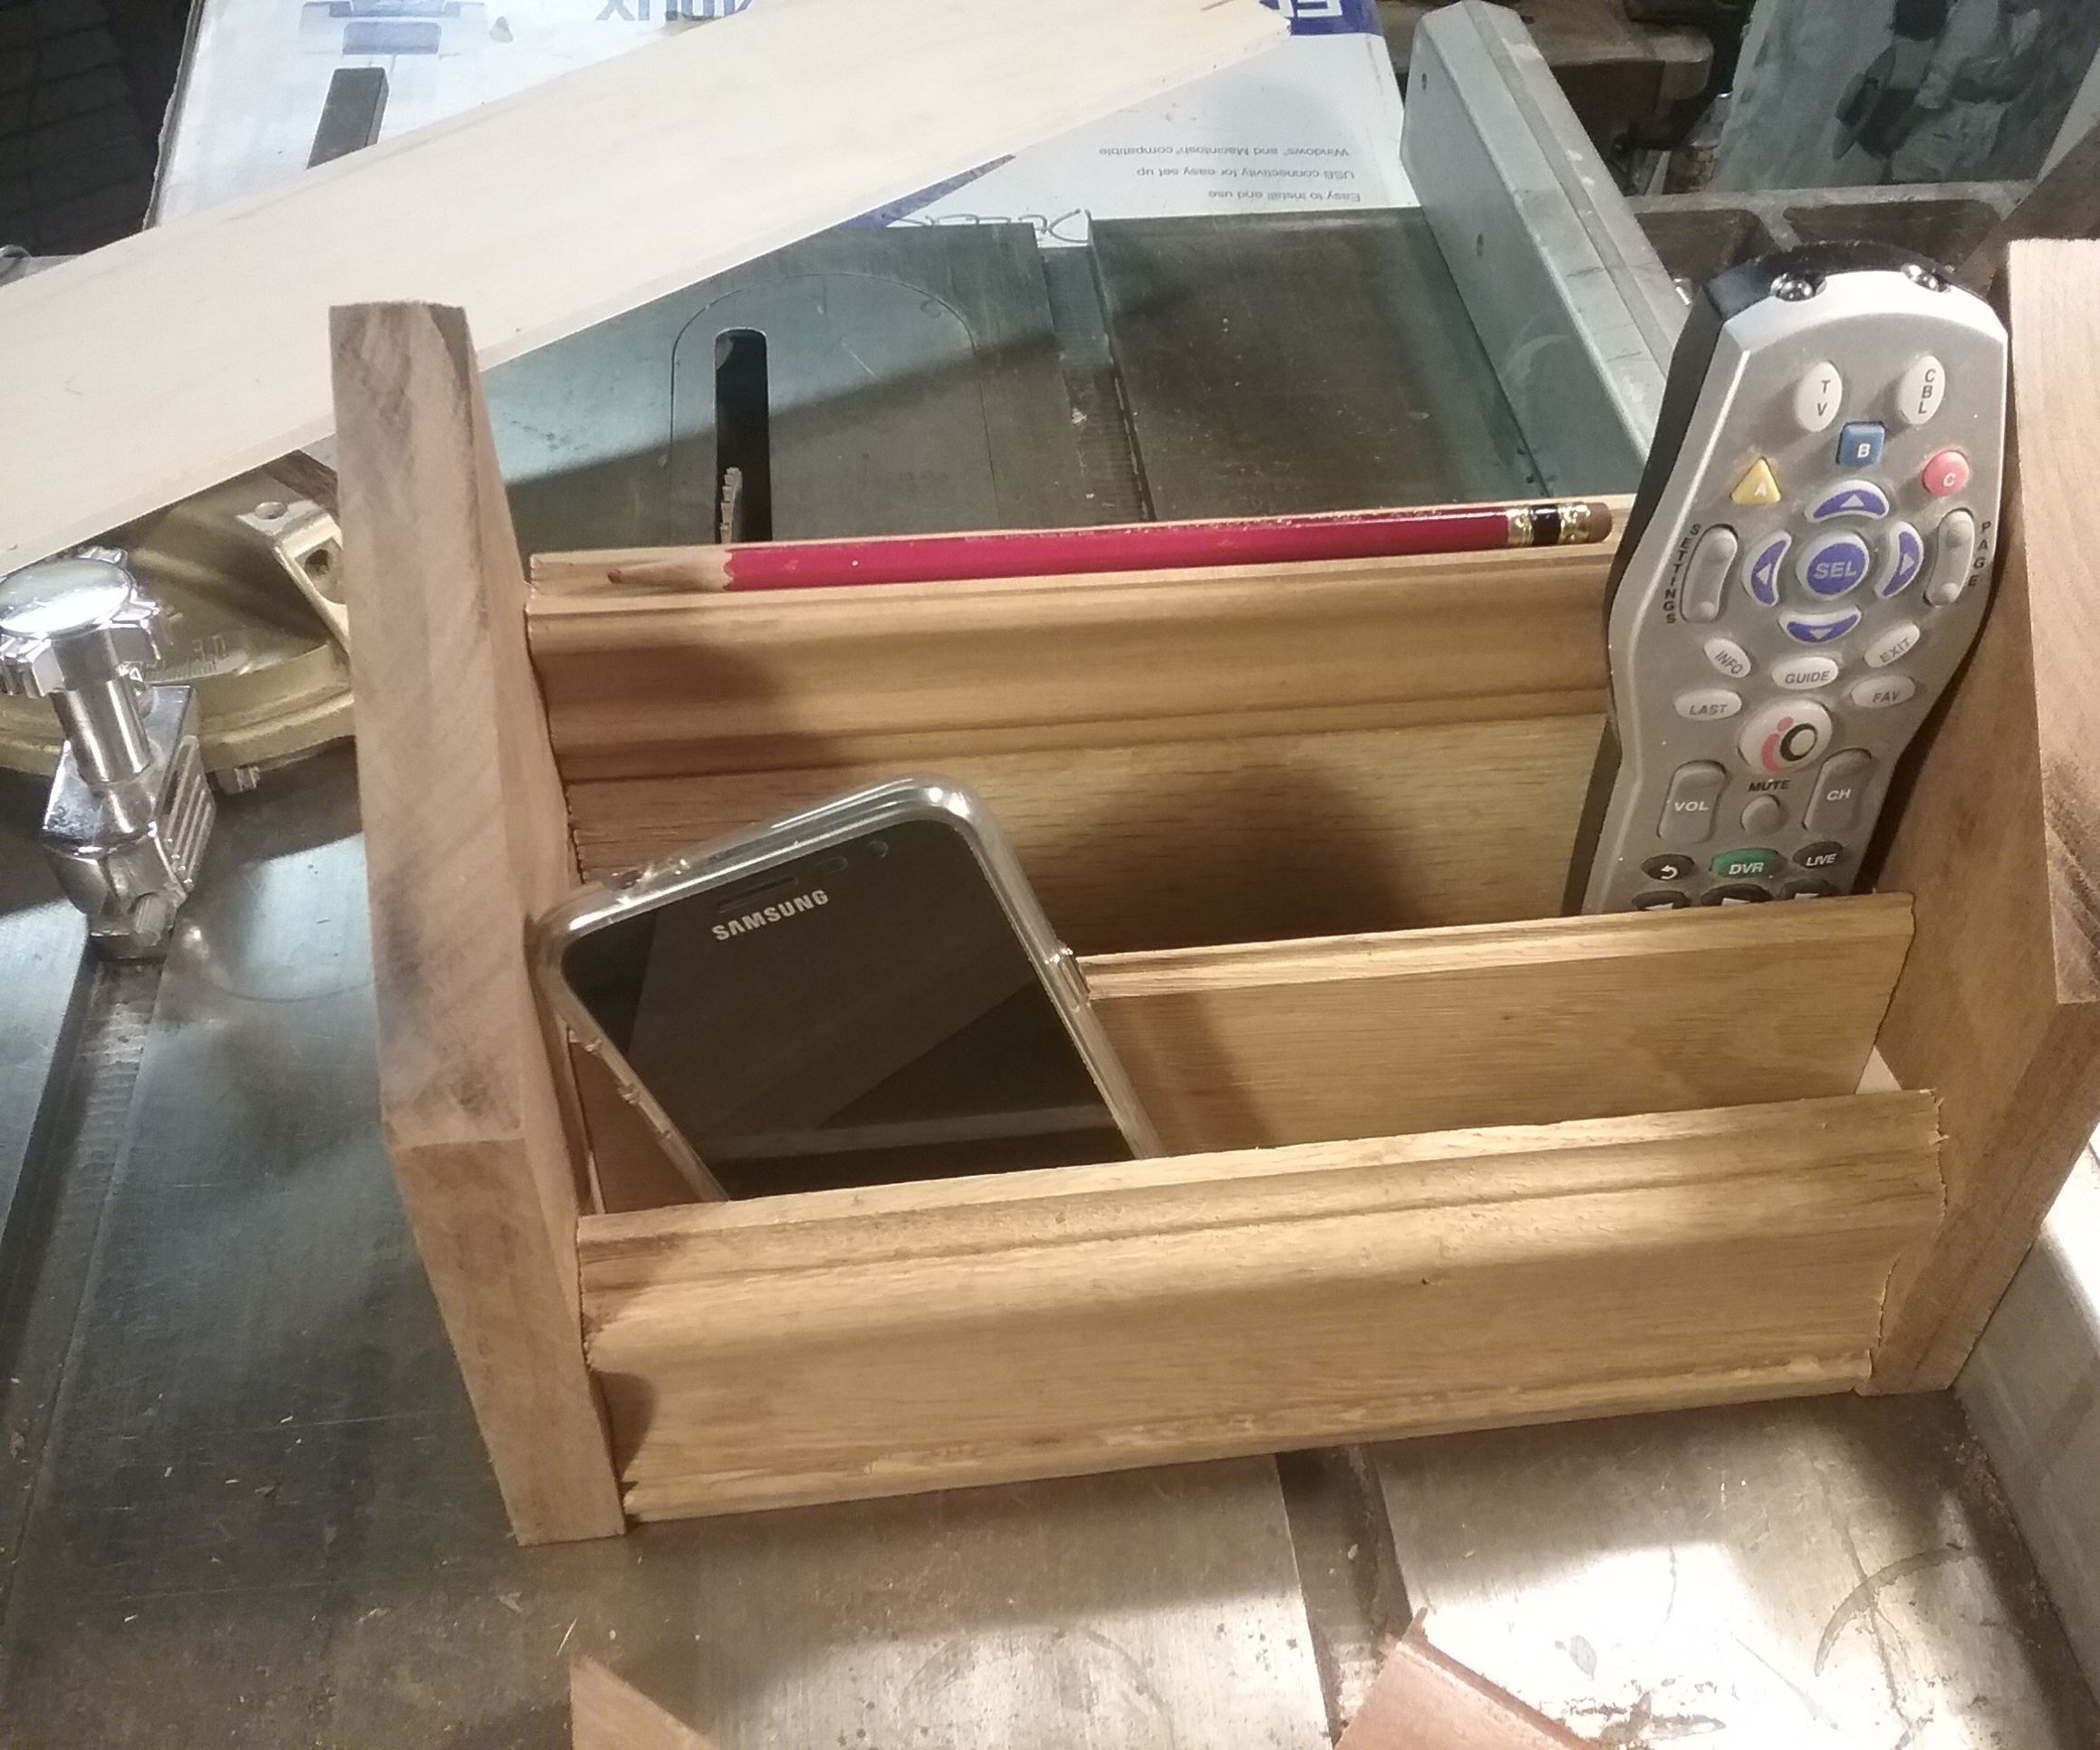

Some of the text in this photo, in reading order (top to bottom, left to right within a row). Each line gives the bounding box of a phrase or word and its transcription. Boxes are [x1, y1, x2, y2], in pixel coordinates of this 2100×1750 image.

[1098, 147, 1174, 156] compatible
[1253, 147, 1279, 156] and
[1136, 167, 1356, 180] USB connectivity for easy set up
[1208, 190, 1236, 199] use
[1238, 190, 1264, 200] and
[1309, 190, 1324, 201] to
[1326, 190, 1363, 203] Easy
[1917, 368, 1937, 415] CBL
[1816, 380, 1831, 418] TV
[1856, 443, 1871, 458] B
[1942, 472, 1957, 487] C
[1754, 483, 1768, 496] A
[1967, 521, 1992, 588] PAGE
[1662, 524, 1702, 624] SETTINGS
[1813, 560, 1858, 580] SEL
[1879, 636, 1912, 664] EXIT
[1714, 649, 1744, 675] INFO
[1784, 669, 1831, 685] GUIDE
[1872, 689, 1902, 704] FAV
[1689, 704, 1729, 716] LAST
[1748, 779, 1791, 793] MUTE
[1826, 788, 1852, 802] CH
[1674, 801, 1710, 812] VOL
[1806, 853, 1837, 867] LIVE
[1729, 861, 1765, 875] DVR
[711, 889, 830, 941] SAMSUNG
